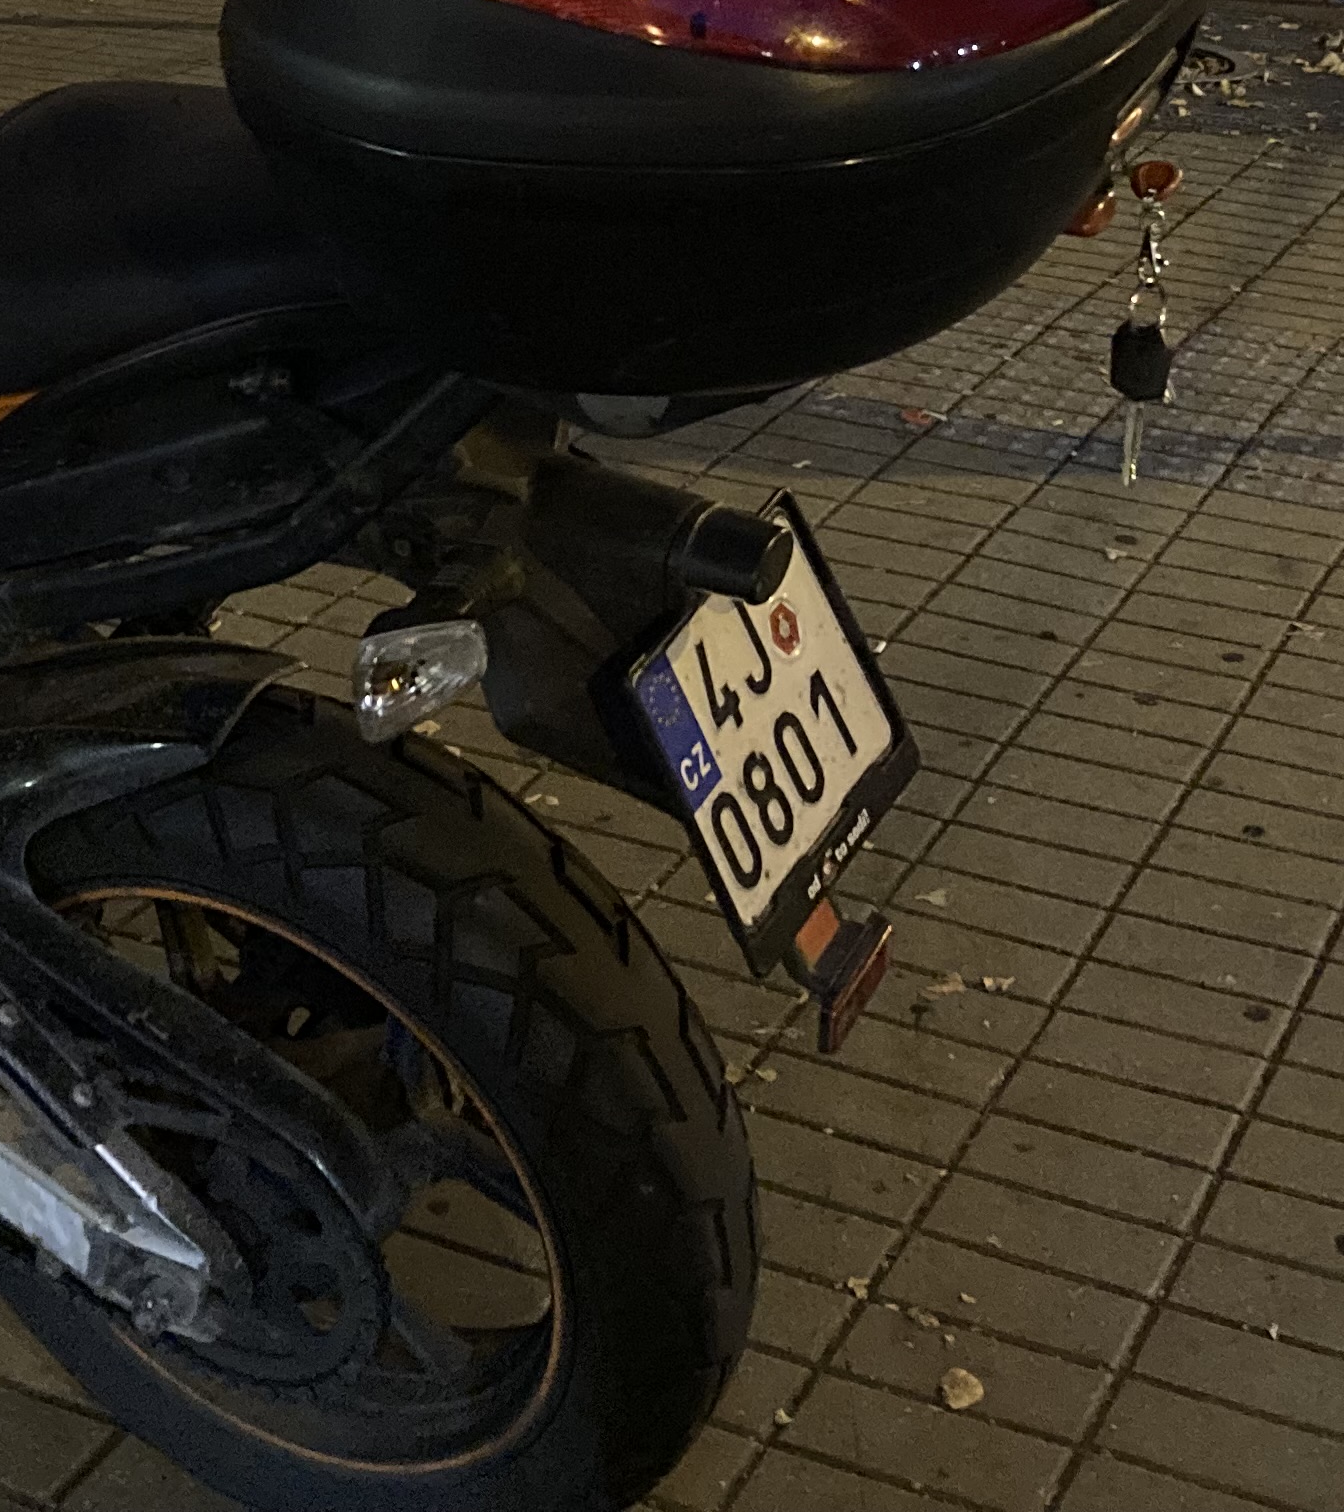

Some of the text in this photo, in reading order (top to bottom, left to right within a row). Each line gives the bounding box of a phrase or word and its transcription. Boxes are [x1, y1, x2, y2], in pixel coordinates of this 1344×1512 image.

[695, 597, 772, 729] 4J
[680, 741, 711, 791] CZ
[711, 668, 858, 890] 0801
